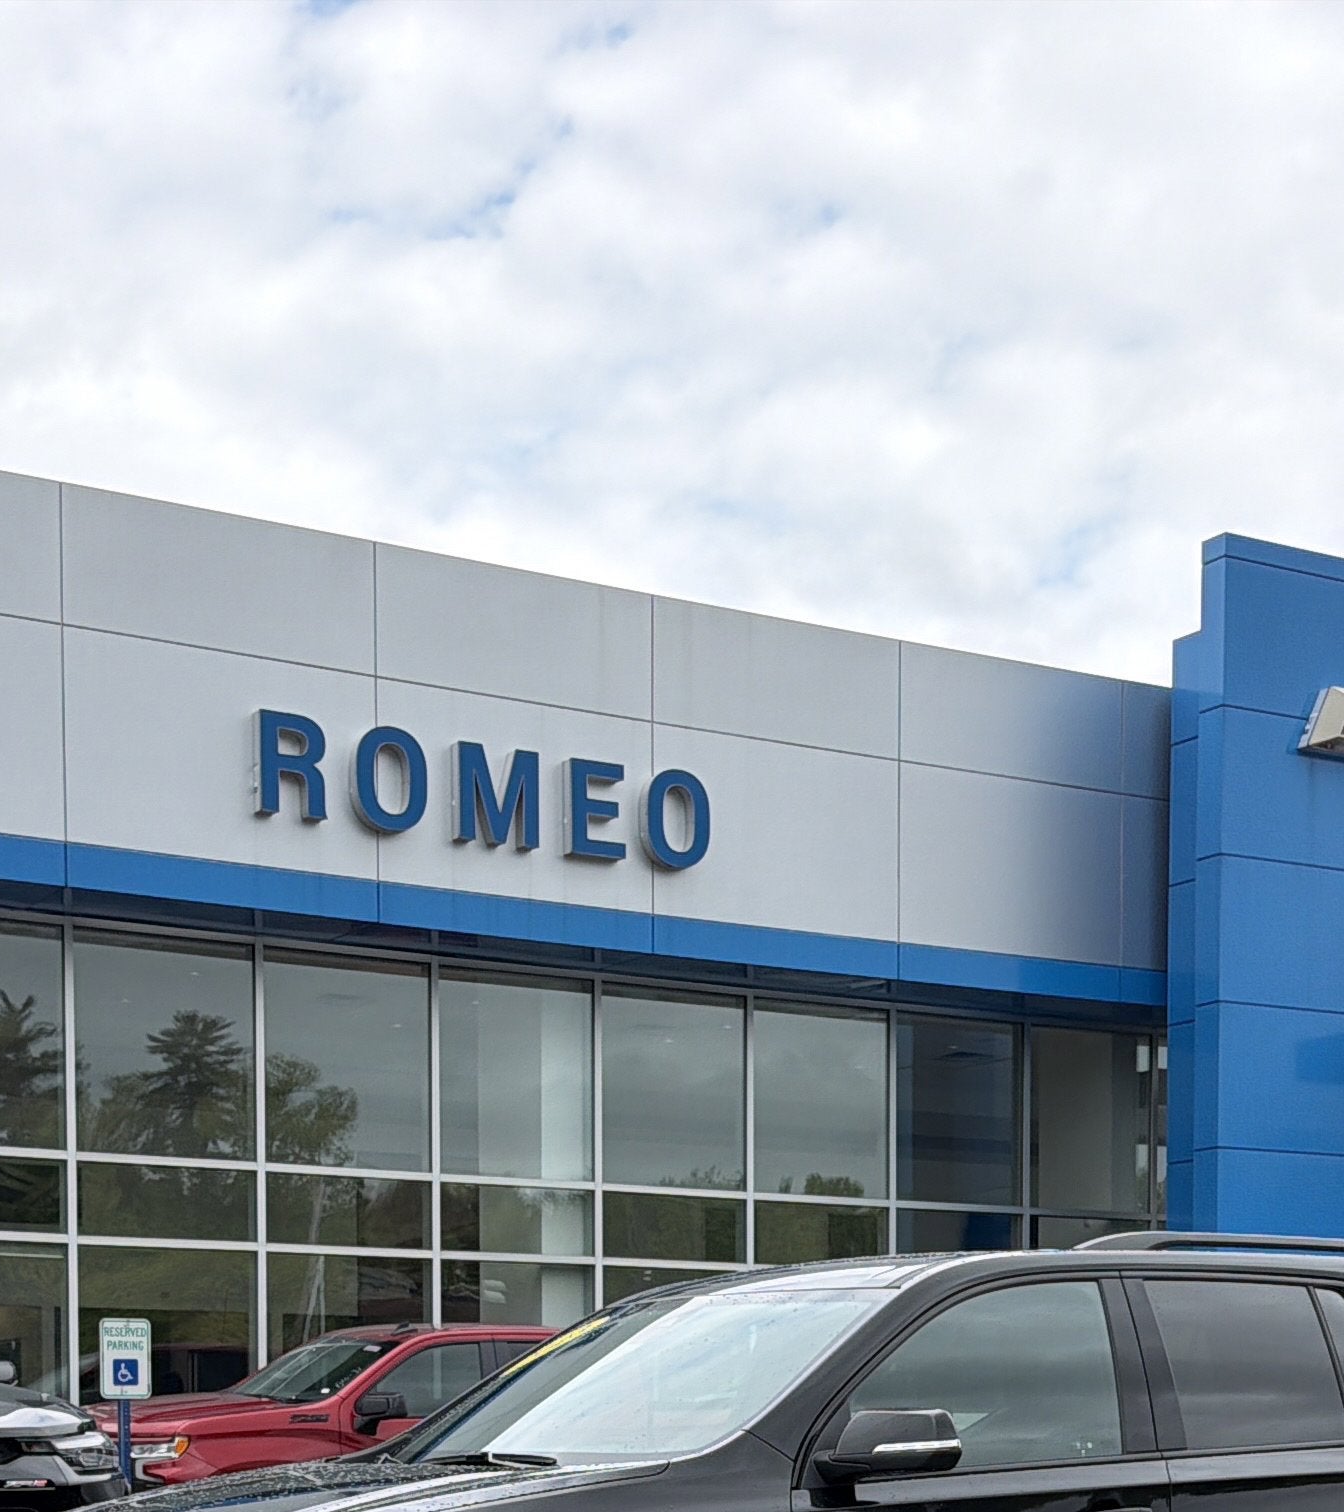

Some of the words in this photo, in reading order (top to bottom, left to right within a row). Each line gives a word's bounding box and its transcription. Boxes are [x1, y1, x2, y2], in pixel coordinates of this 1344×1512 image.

[254, 708, 711, 871] ROMEO
[103, 1326, 147, 1337] RESERVED
[106, 1340, 145, 1351] PARKING
